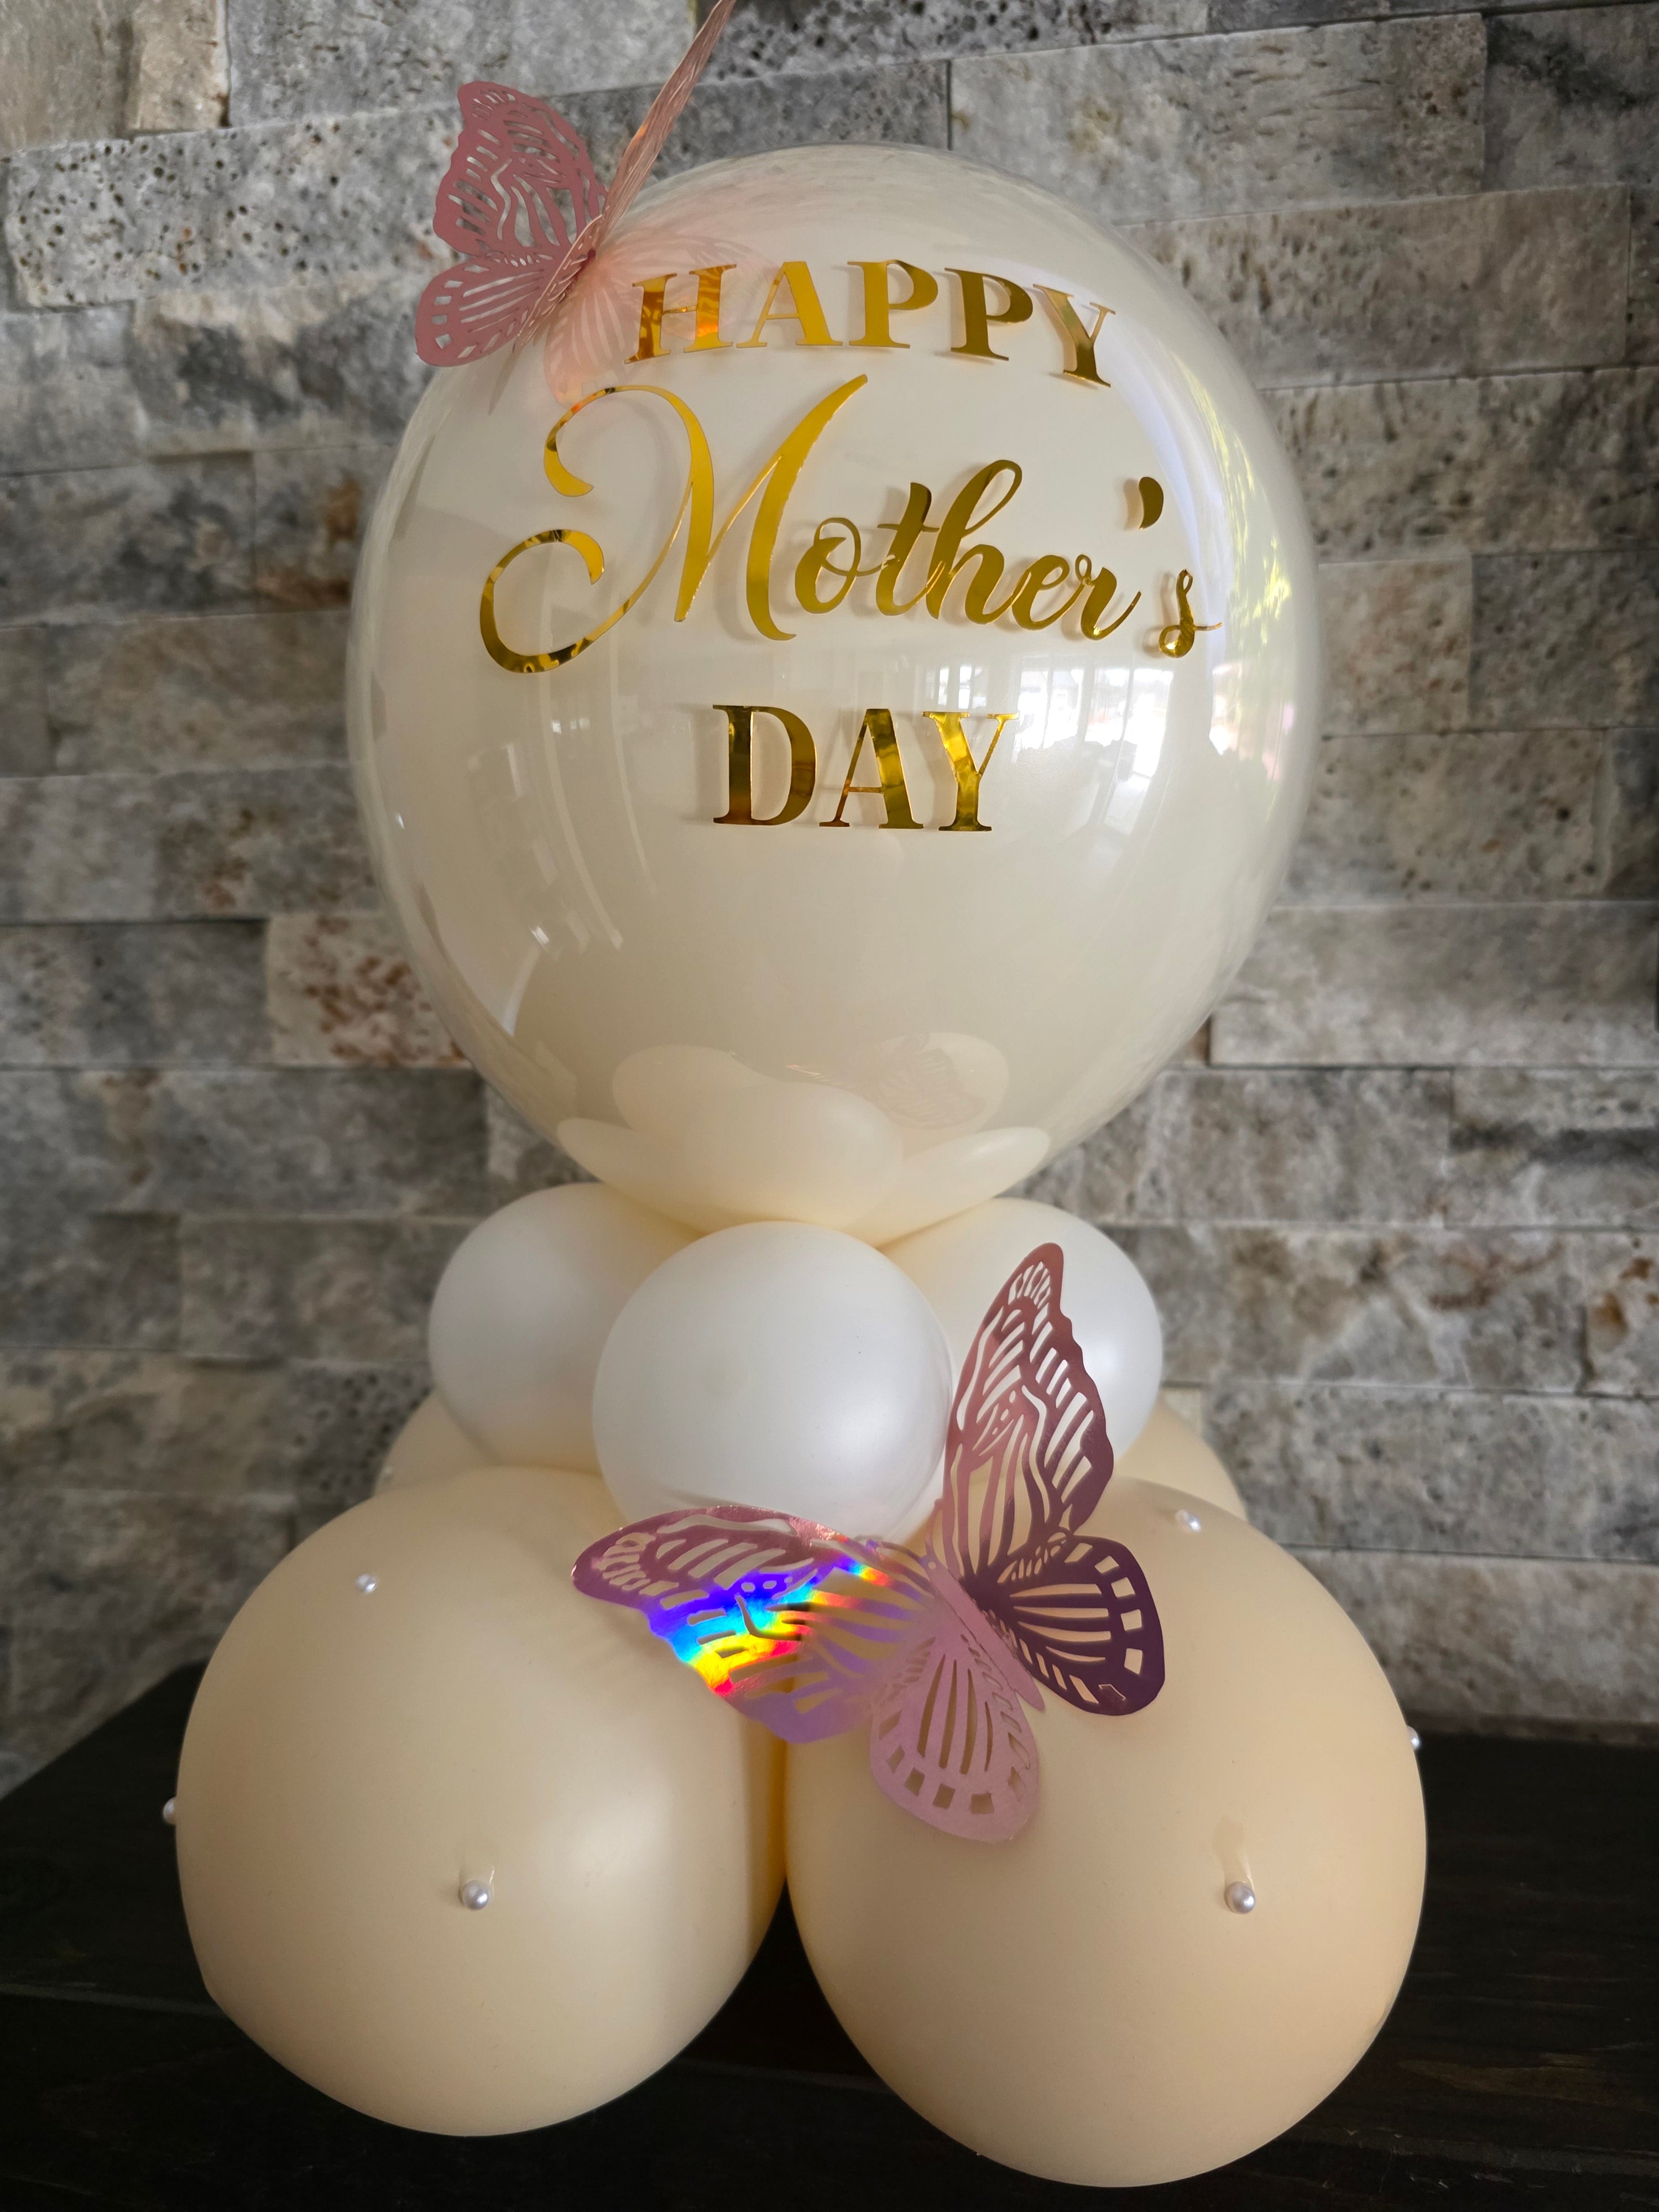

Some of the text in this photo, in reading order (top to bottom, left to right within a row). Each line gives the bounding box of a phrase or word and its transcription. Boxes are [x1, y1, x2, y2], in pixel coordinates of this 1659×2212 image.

[624, 259, 1115, 388] HAPPY
[479, 374, 1223, 674] Mother's
[712, 704, 1019, 832] DAY
